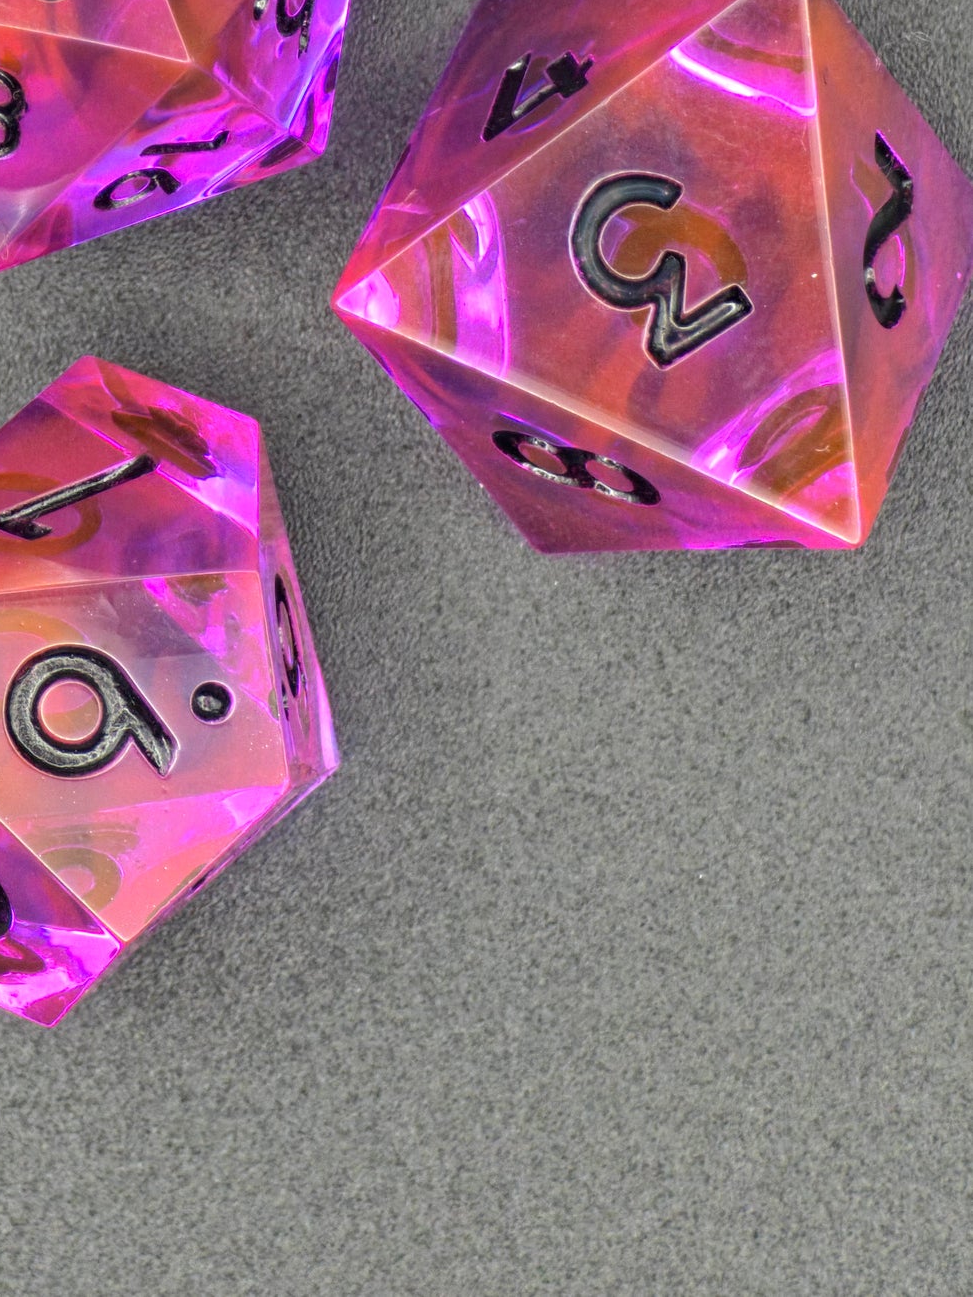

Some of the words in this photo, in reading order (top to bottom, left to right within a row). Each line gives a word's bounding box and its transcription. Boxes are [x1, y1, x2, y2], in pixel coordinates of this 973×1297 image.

[480, 51, 595, 142] 4
[568, 170, 755, 370] 3
[491, 429, 662, 507] 8
